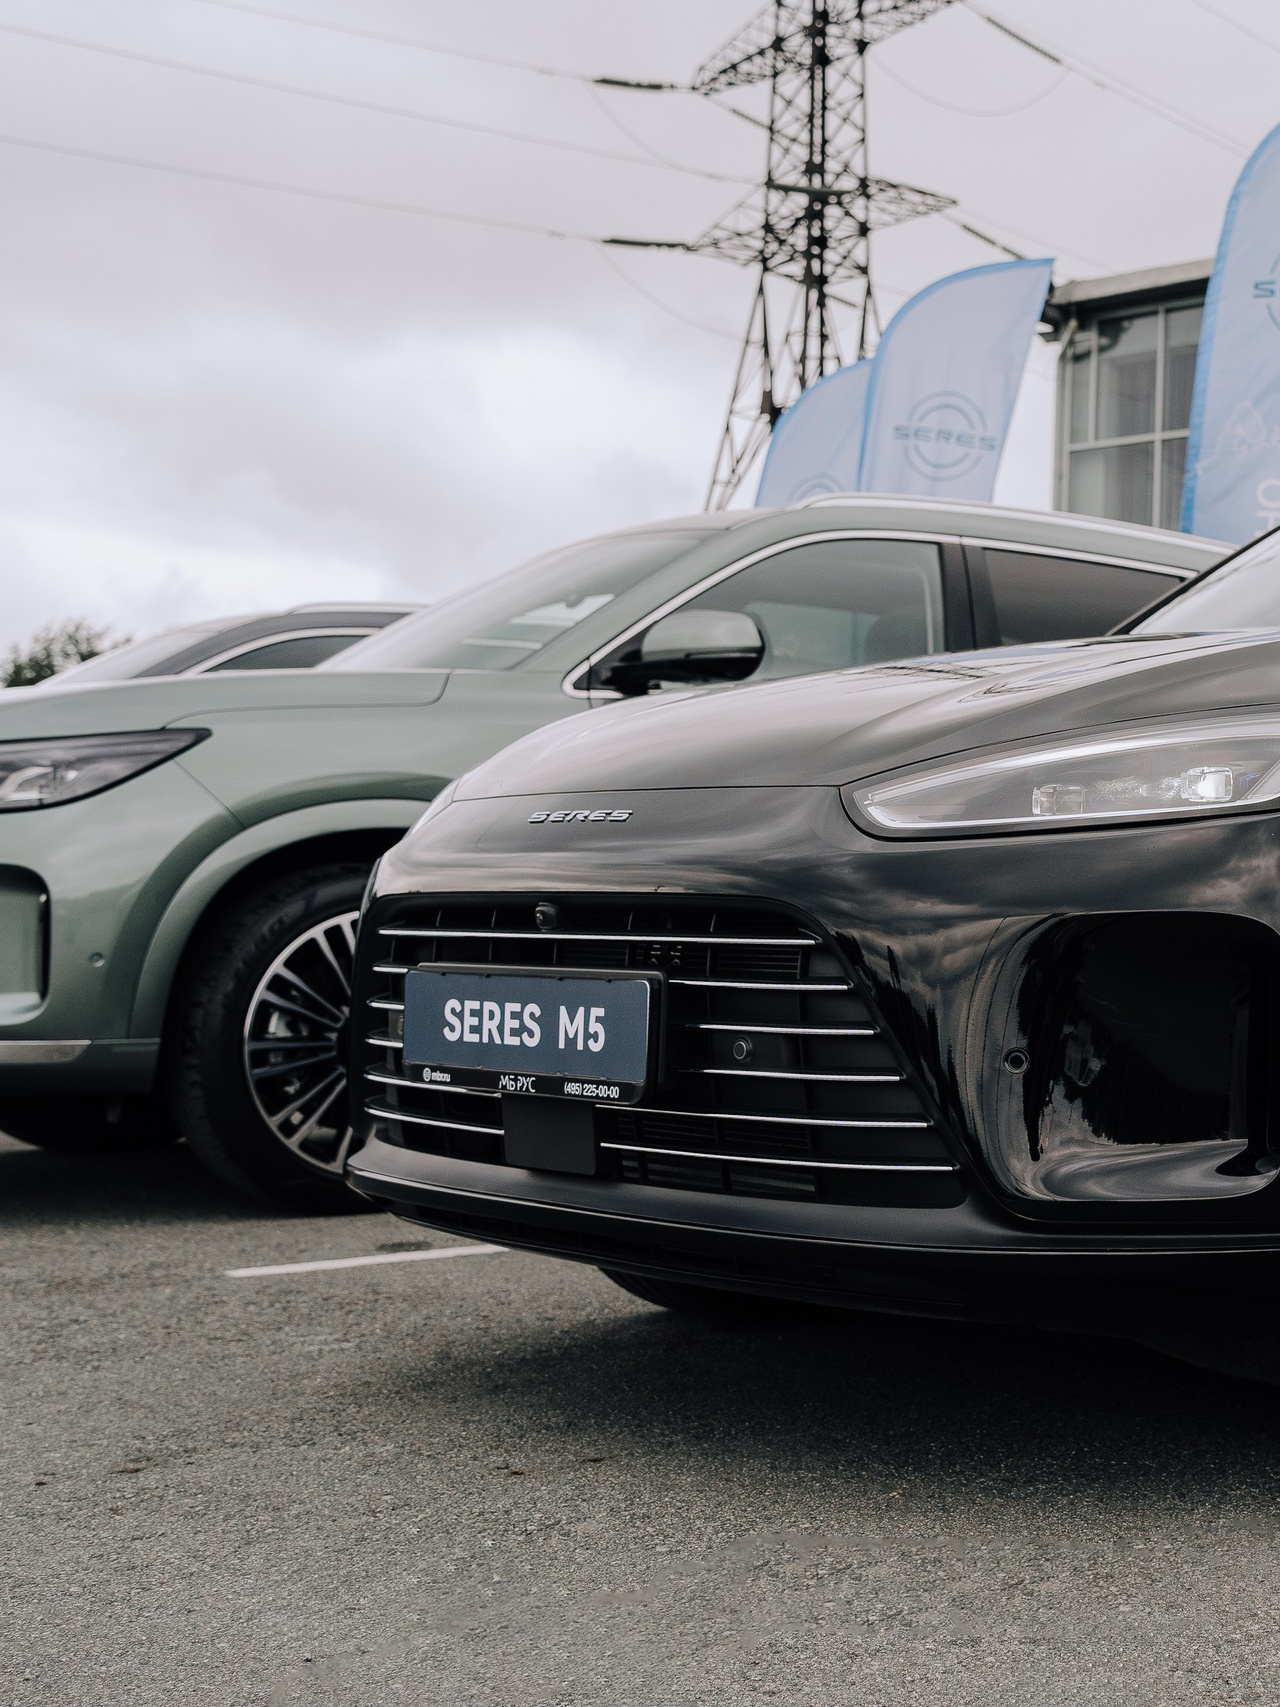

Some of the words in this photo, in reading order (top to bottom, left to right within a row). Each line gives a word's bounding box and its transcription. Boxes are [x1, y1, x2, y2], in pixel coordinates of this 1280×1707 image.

[892, 424, 997, 452] SERES
[527, 809, 633, 824] SERES
[442, 998, 542, 1048] SERES
[558, 1005, 606, 1053] M5
[498, 1074, 516, 1091] МБ
[517, 1076, 536, 1093] РУС
[564, 1081, 582, 1096] (495)
[583, 1083, 620, 1099] 225-00-00
